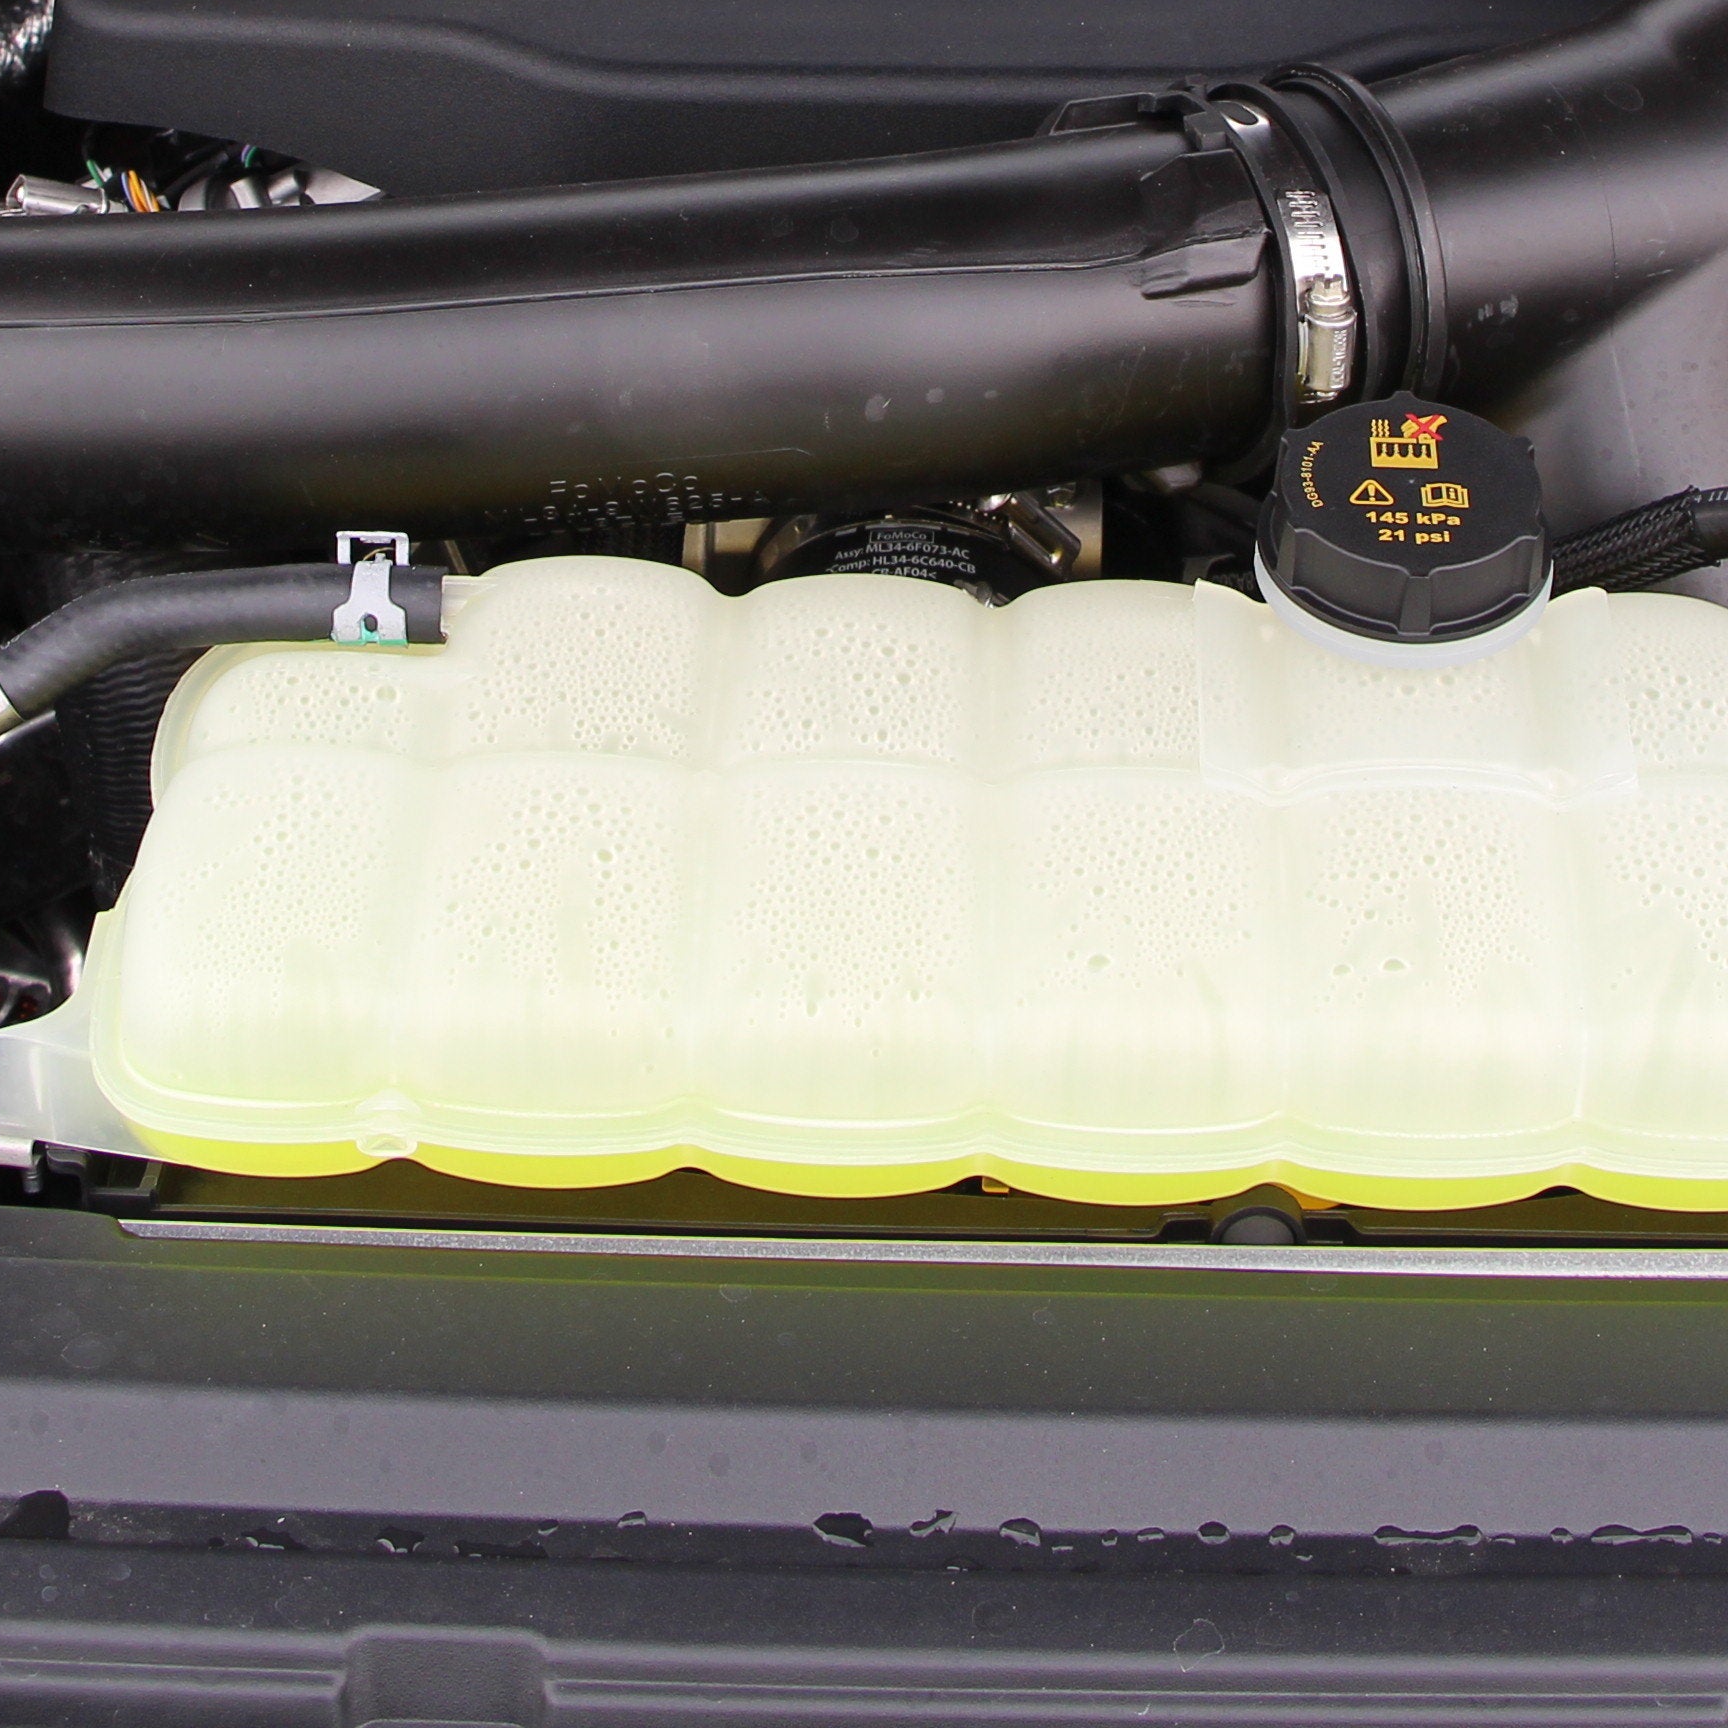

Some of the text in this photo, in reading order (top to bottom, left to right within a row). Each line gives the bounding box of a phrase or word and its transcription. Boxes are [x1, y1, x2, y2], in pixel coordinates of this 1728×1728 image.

[1366, 510, 1461, 526] 145 kPa
[876, 532, 927, 541] FoMoCo
[1378, 528, 1451, 545] 21 psi
[834, 542, 970, 560] Assy: ML34-6F073-AC
[828, 556, 977, 574] Comp: HL34-6C640-CB
